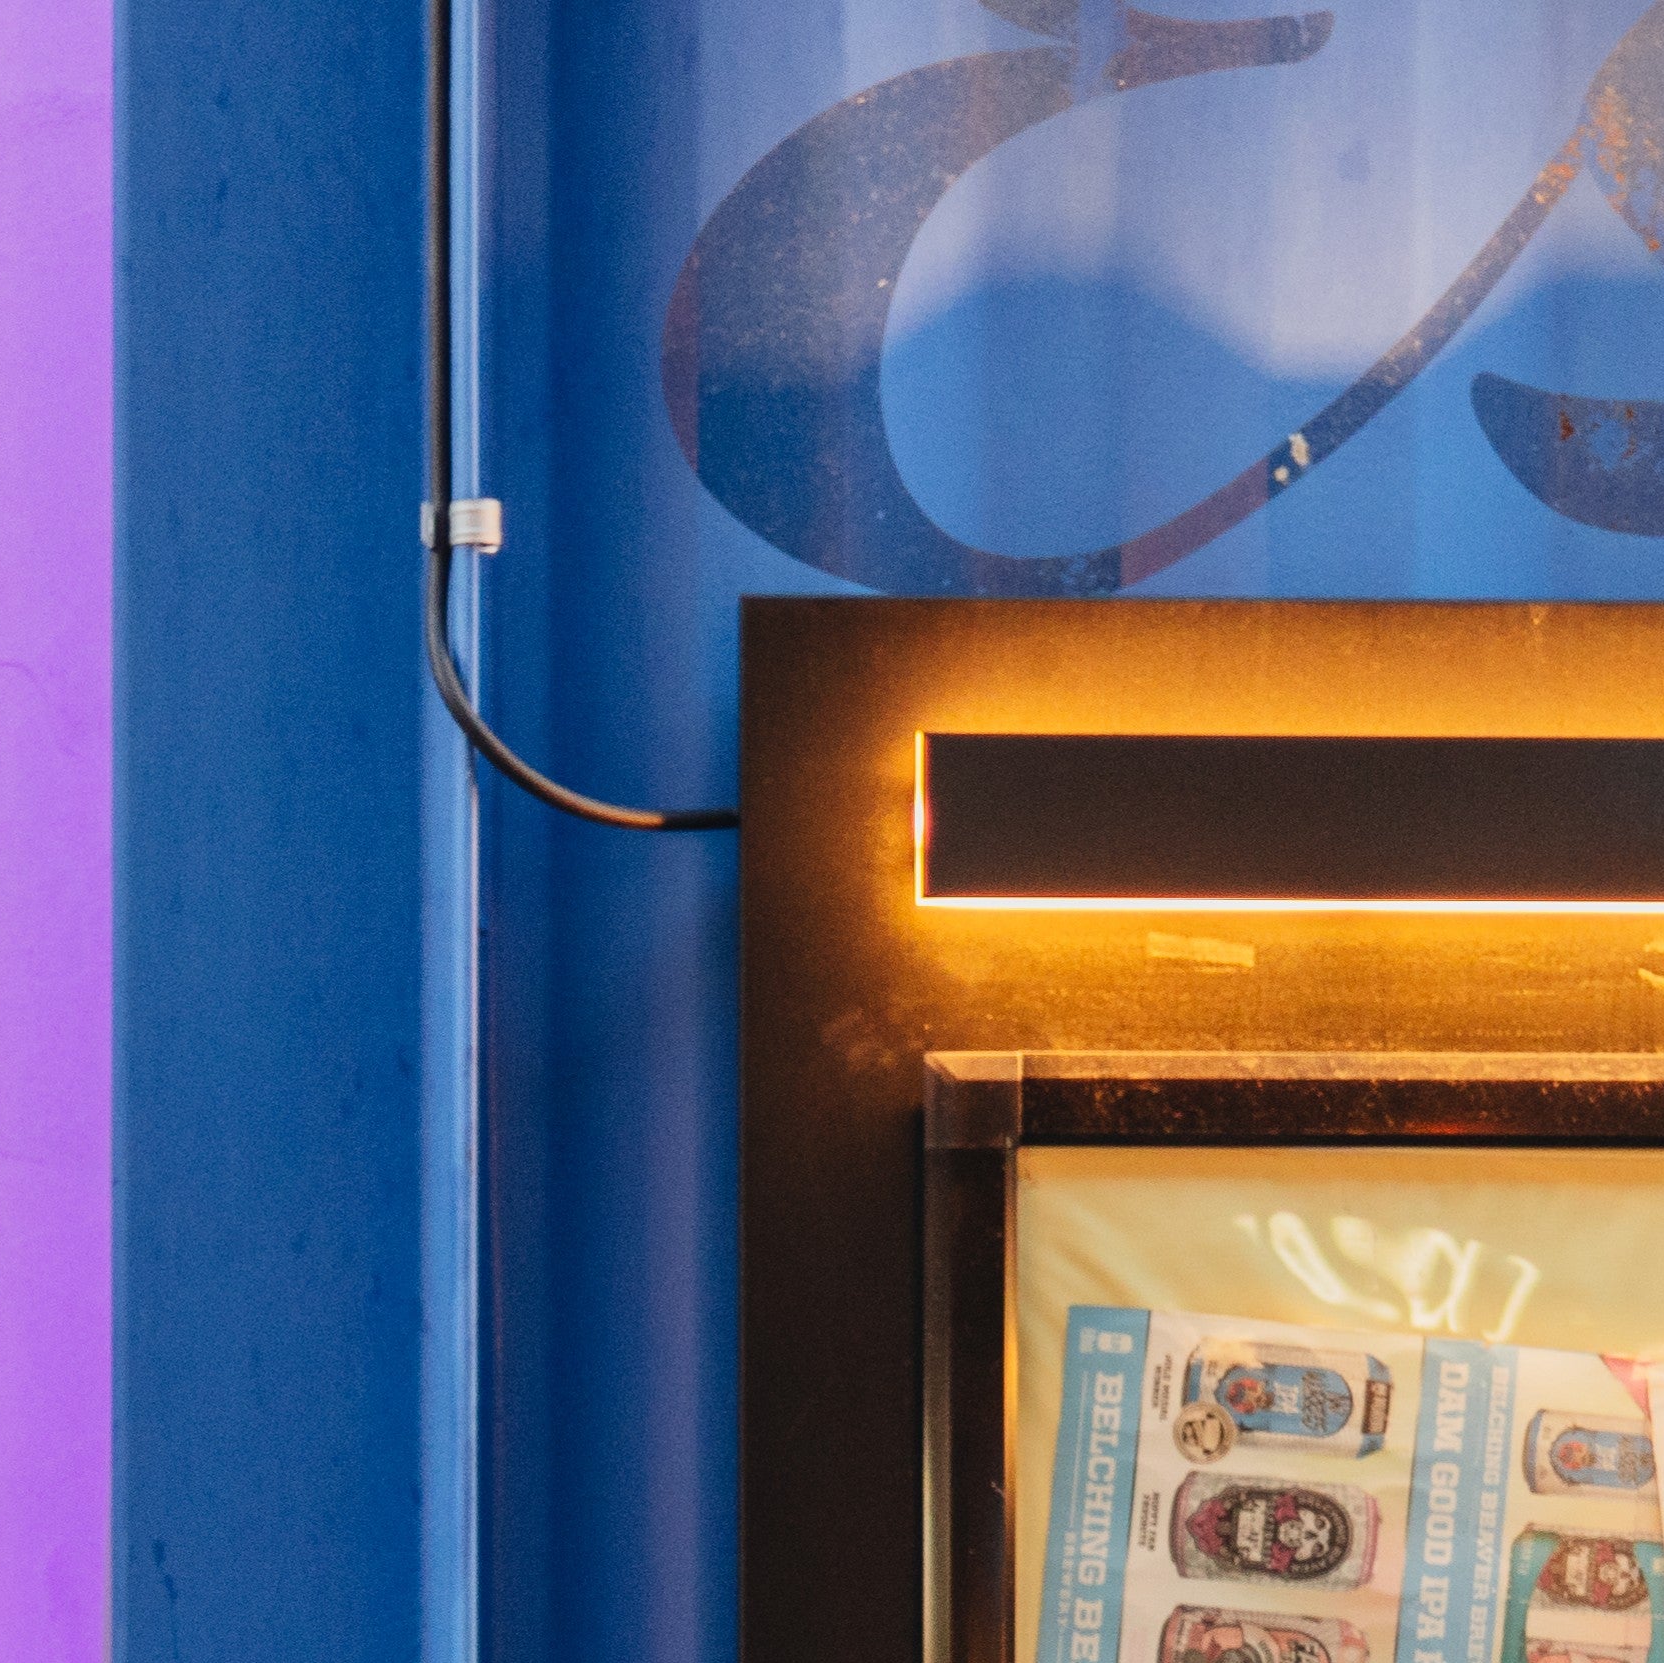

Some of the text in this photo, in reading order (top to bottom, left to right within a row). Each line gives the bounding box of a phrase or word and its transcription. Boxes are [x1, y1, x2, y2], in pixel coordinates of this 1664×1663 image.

[1433, 1361, 1469, 1452] DAM
[1482, 1366, 1509, 1485] BELCHING
[1078, 1371, 1124, 1586] BELCHING
[1423, 1462, 1459, 1564] GOOD
[1471, 1492, 1497, 1601] BEAVER
[1416, 1575, 1450, 1639] IPA
